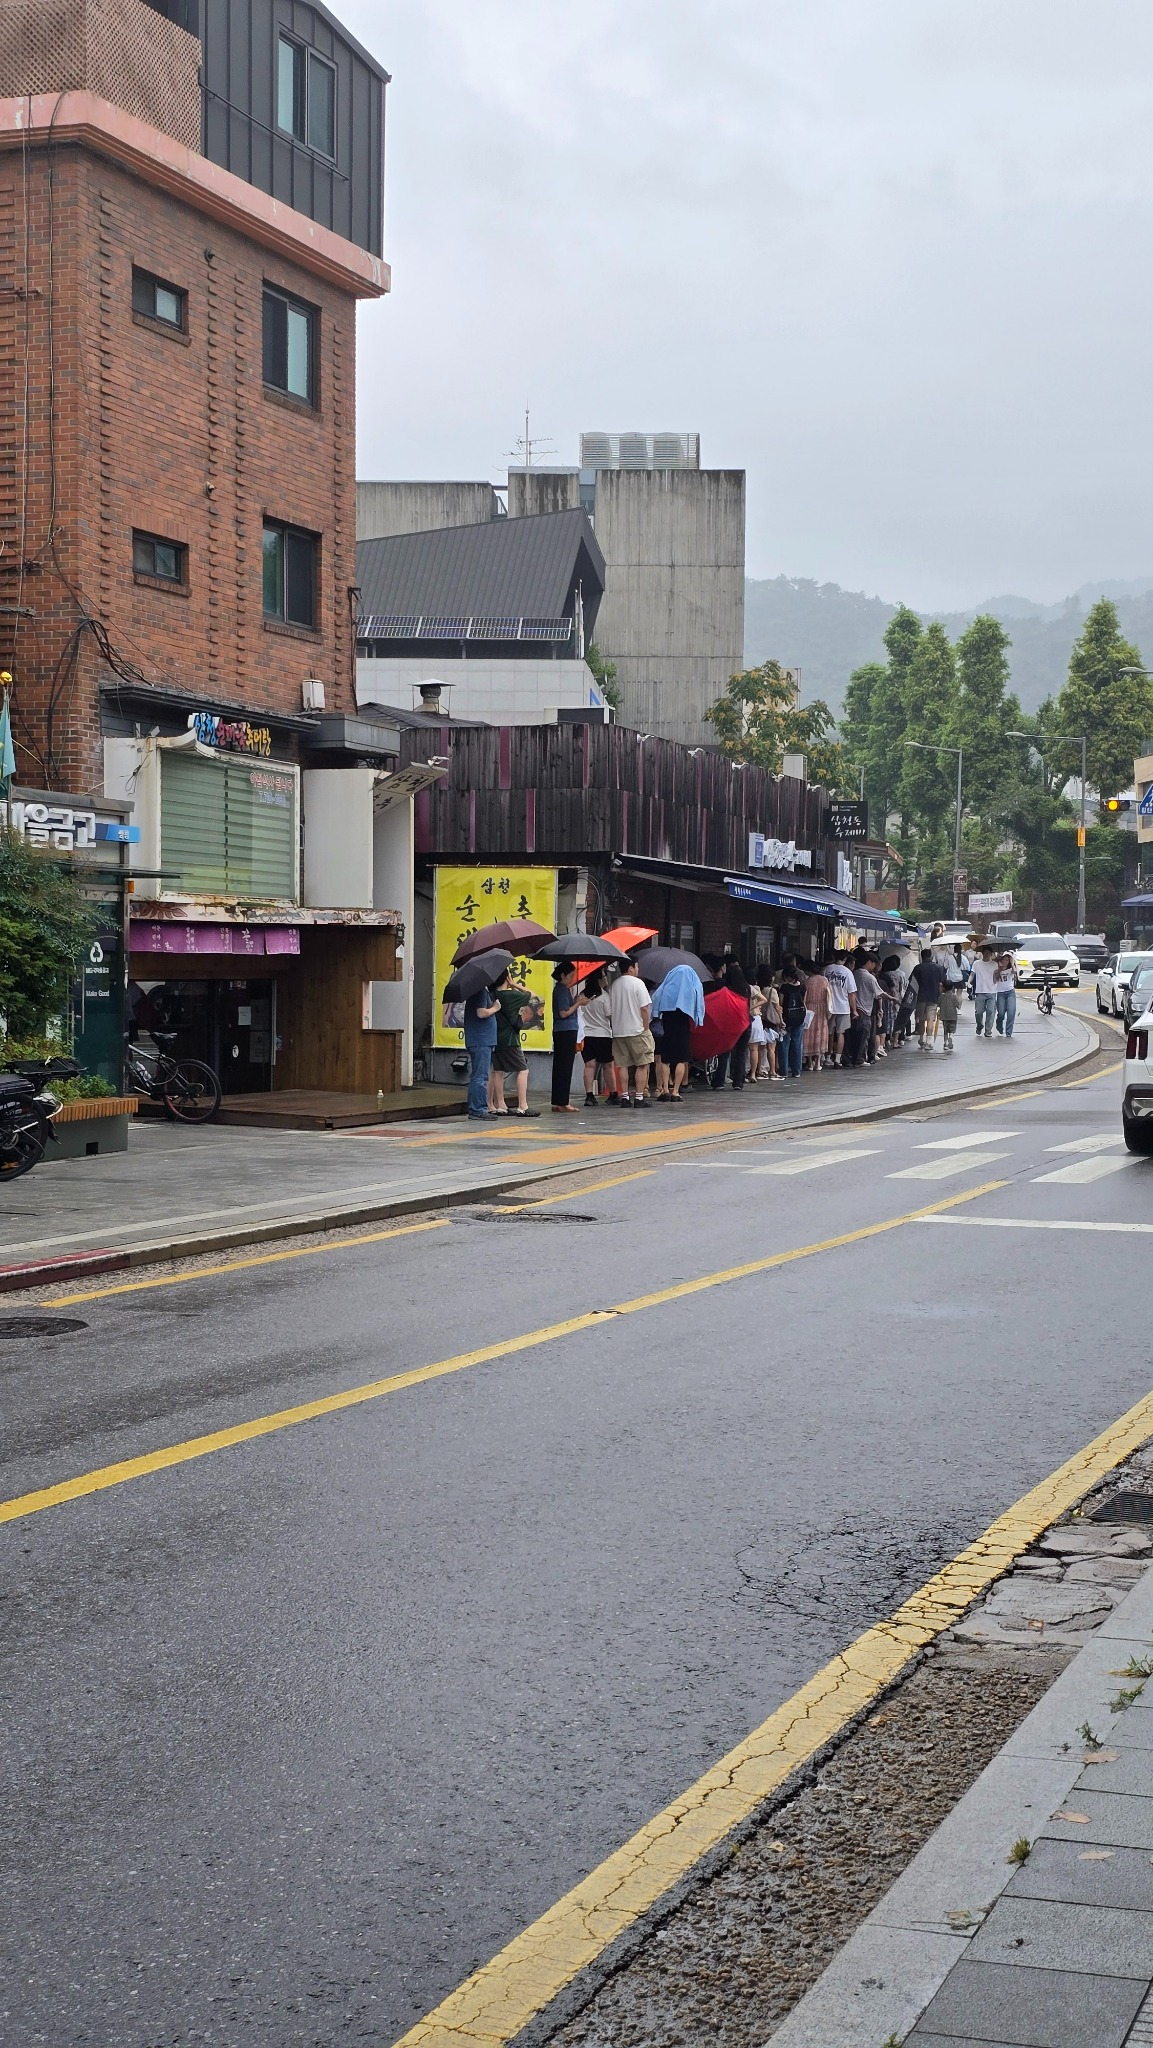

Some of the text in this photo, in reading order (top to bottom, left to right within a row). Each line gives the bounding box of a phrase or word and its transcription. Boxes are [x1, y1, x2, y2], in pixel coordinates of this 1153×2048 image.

[245, 722, 271, 757] 추어탕
[830, 815, 862, 826] 삼청동
[834, 826, 867, 839] 수제비
[480, 877, 511, 895] 삼청
